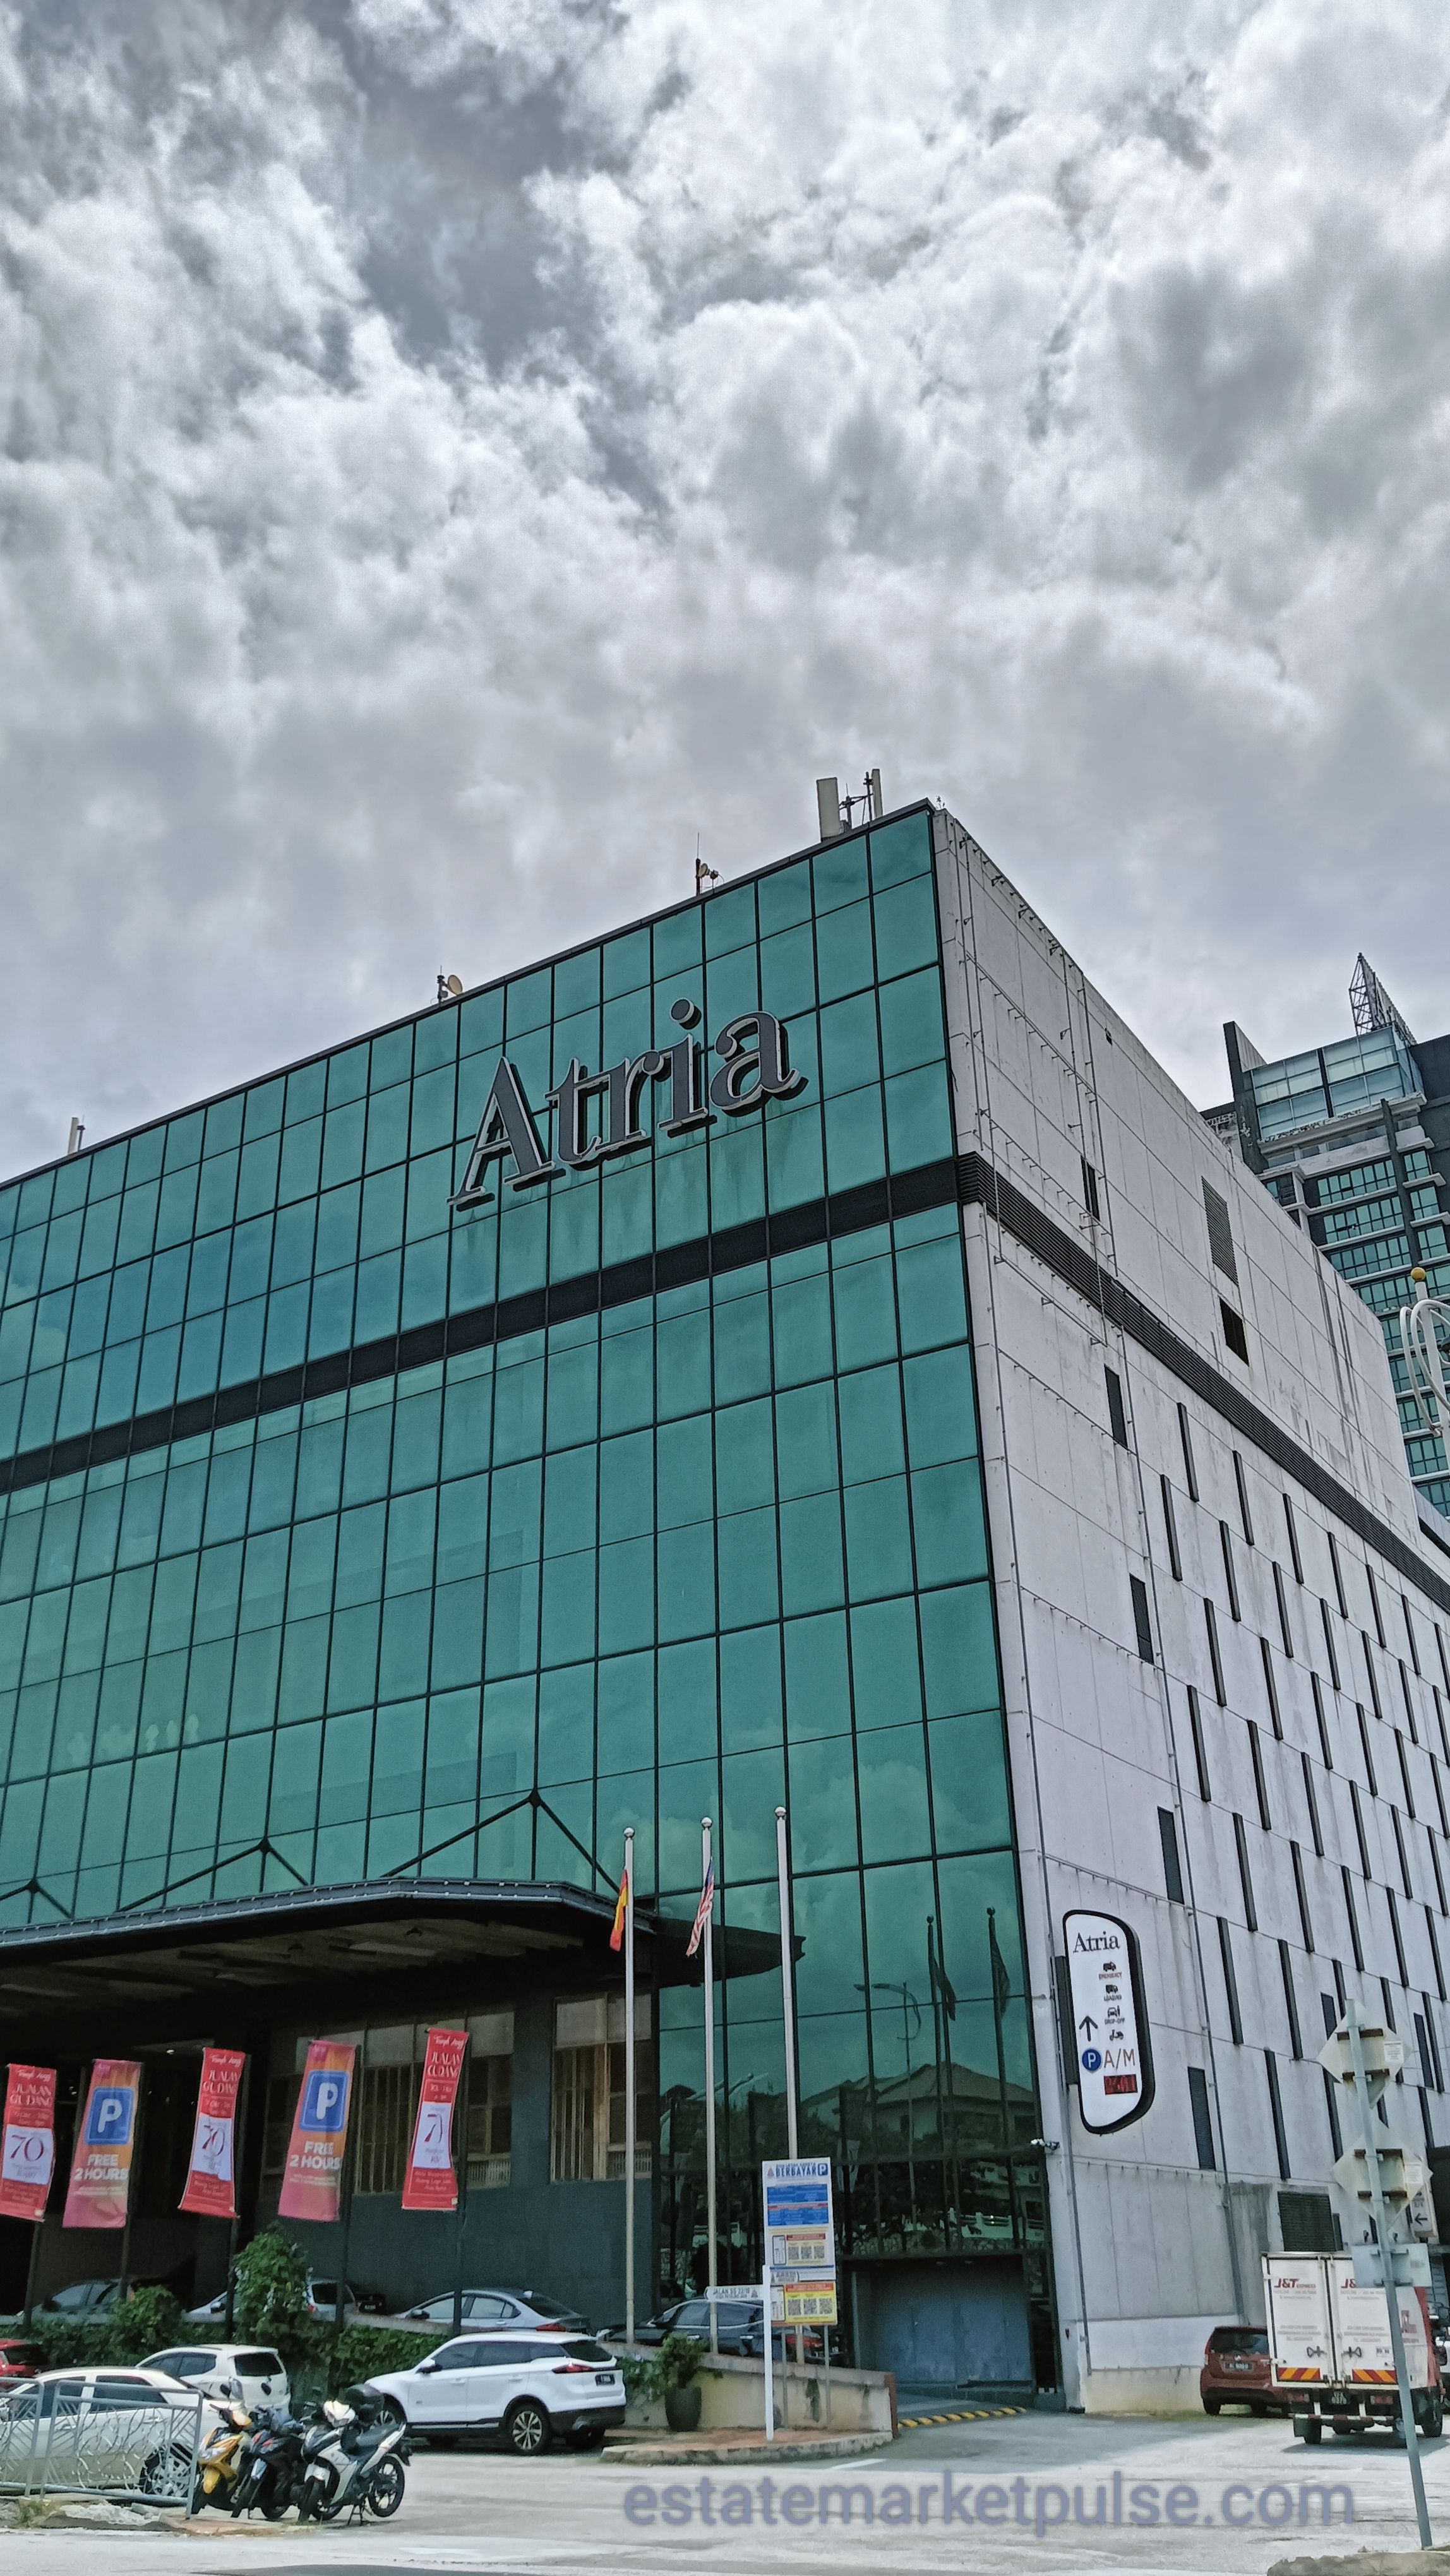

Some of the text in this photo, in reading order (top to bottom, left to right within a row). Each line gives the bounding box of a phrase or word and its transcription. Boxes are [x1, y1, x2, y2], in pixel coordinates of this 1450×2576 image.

[446, 998, 801, 1207] Atria
[1073, 1931, 1120, 1953] Atria
[1099, 1972, 1122, 1980] EMERGENCY
[1088, 2049, 1135, 2070] P A/M
[316, 2082, 339, 2120] P
[97, 2098, 123, 2133] P
[10, 2135, 44, 2161] 70
[202, 2125, 225, 2156] 70
[304, 2141, 334, 2155] FREE
[88, 2154, 119, 2167] FREE
[289, 2155, 342, 2170] 2 HOURS
[74, 2168, 129, 2181] 2 HOURS
[776, 2166, 817, 2178] BERBAYAR
[1274, 2278, 1300, 2289] J&T
[1341, 2278, 1356, 2289] J&
